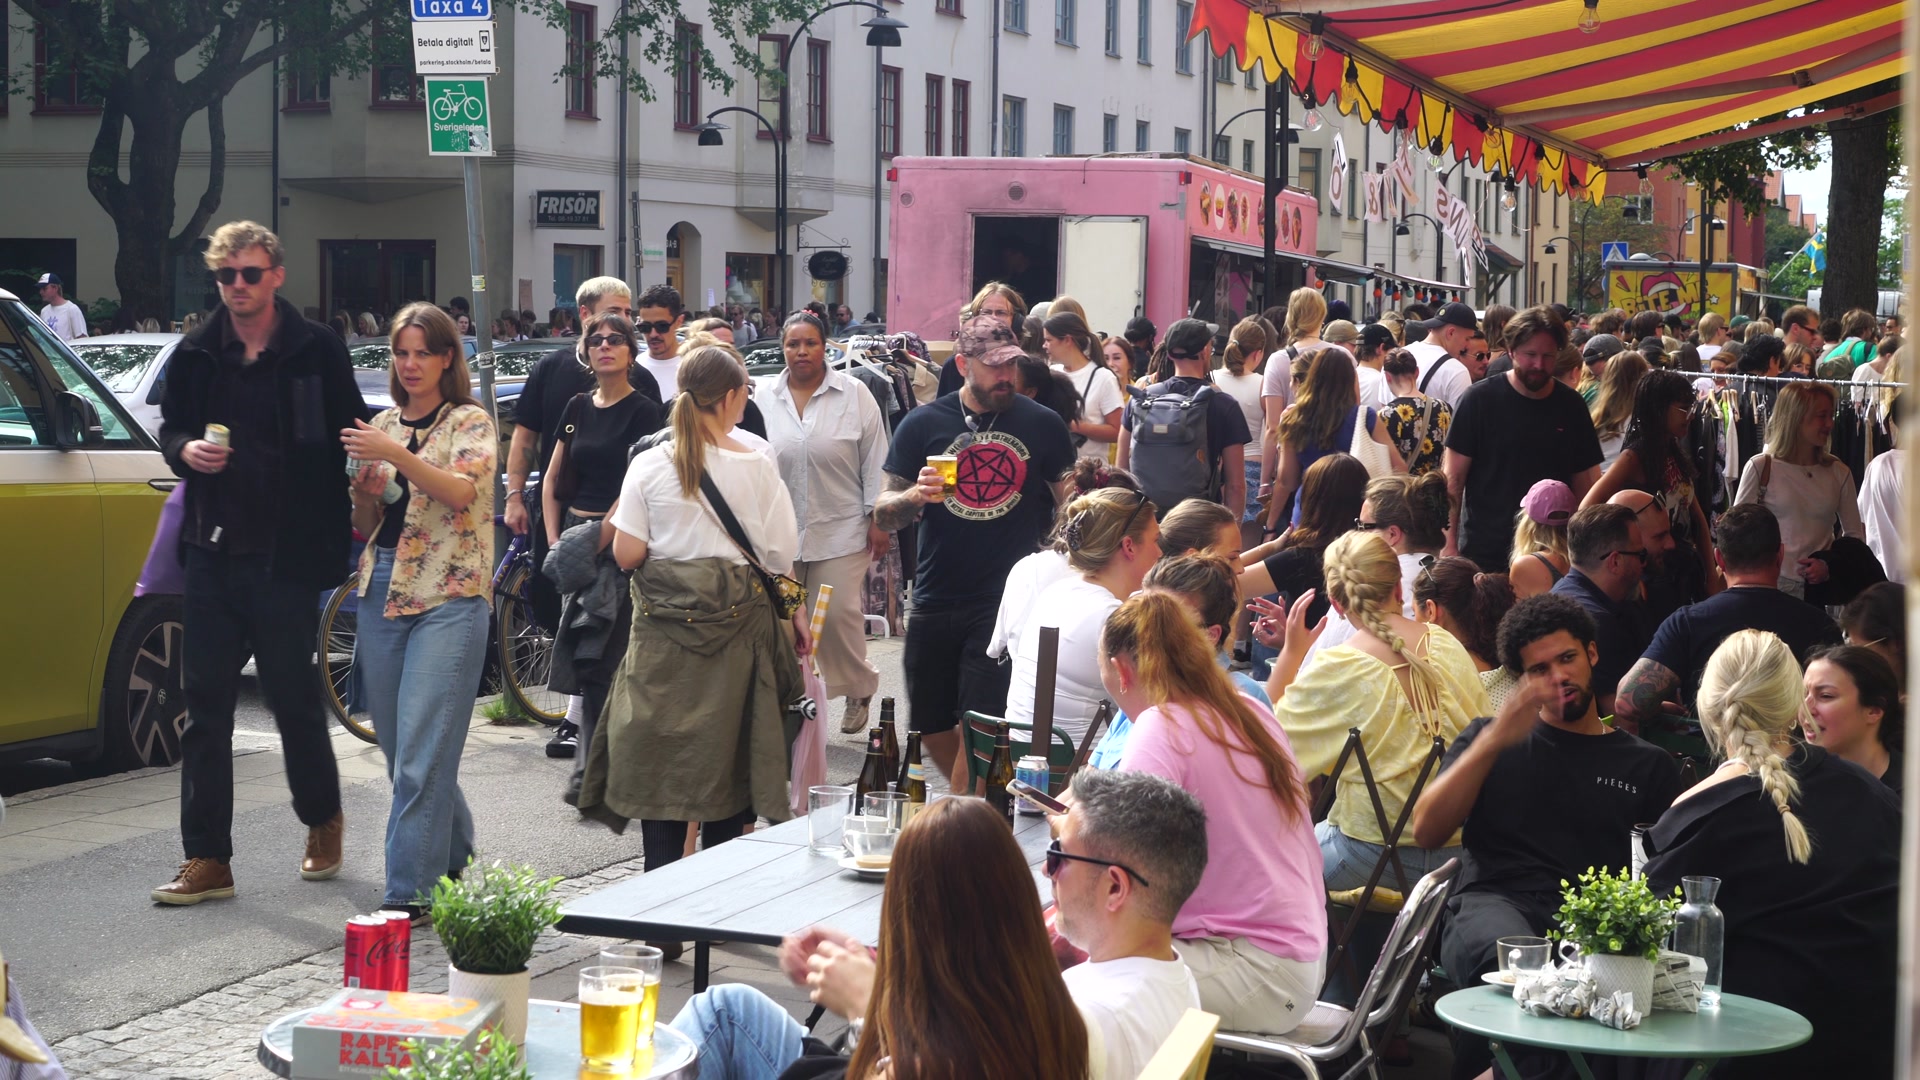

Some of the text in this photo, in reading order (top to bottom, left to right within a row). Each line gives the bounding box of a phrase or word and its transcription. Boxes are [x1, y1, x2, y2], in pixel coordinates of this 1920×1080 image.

[419, 0, 483, 14] Taxa 4
[417, 38, 474, 48] Betala digitalt
[419, 59, 492, 67] parkering.stockholm/betala
[538, 192, 598, 214] FRISÖR
[1596, 776, 1637, 794] PIECES
